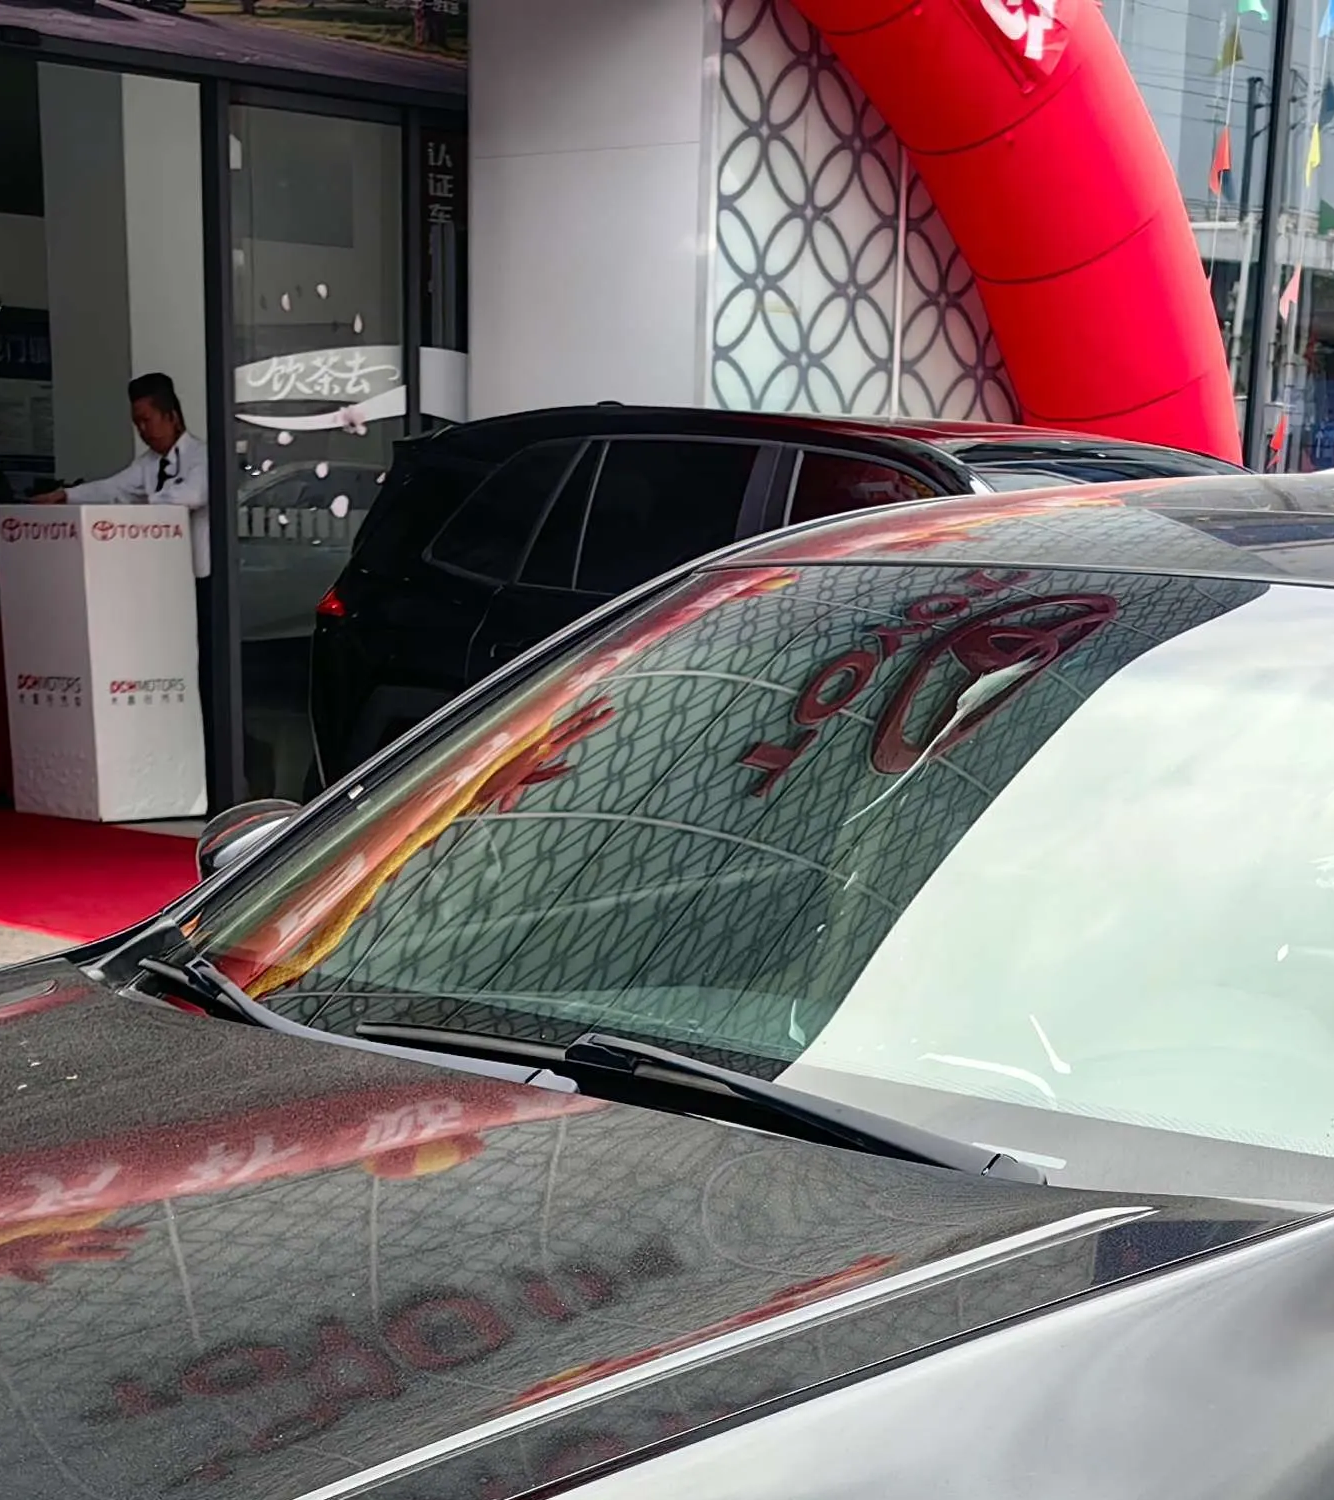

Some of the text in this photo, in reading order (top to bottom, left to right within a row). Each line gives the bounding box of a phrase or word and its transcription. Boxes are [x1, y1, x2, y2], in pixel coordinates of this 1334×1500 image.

[247, 352, 400, 400] 饮茶去
[23, 522, 78, 540] TOYOTA
[119, 523, 183, 539] TOYOTA
